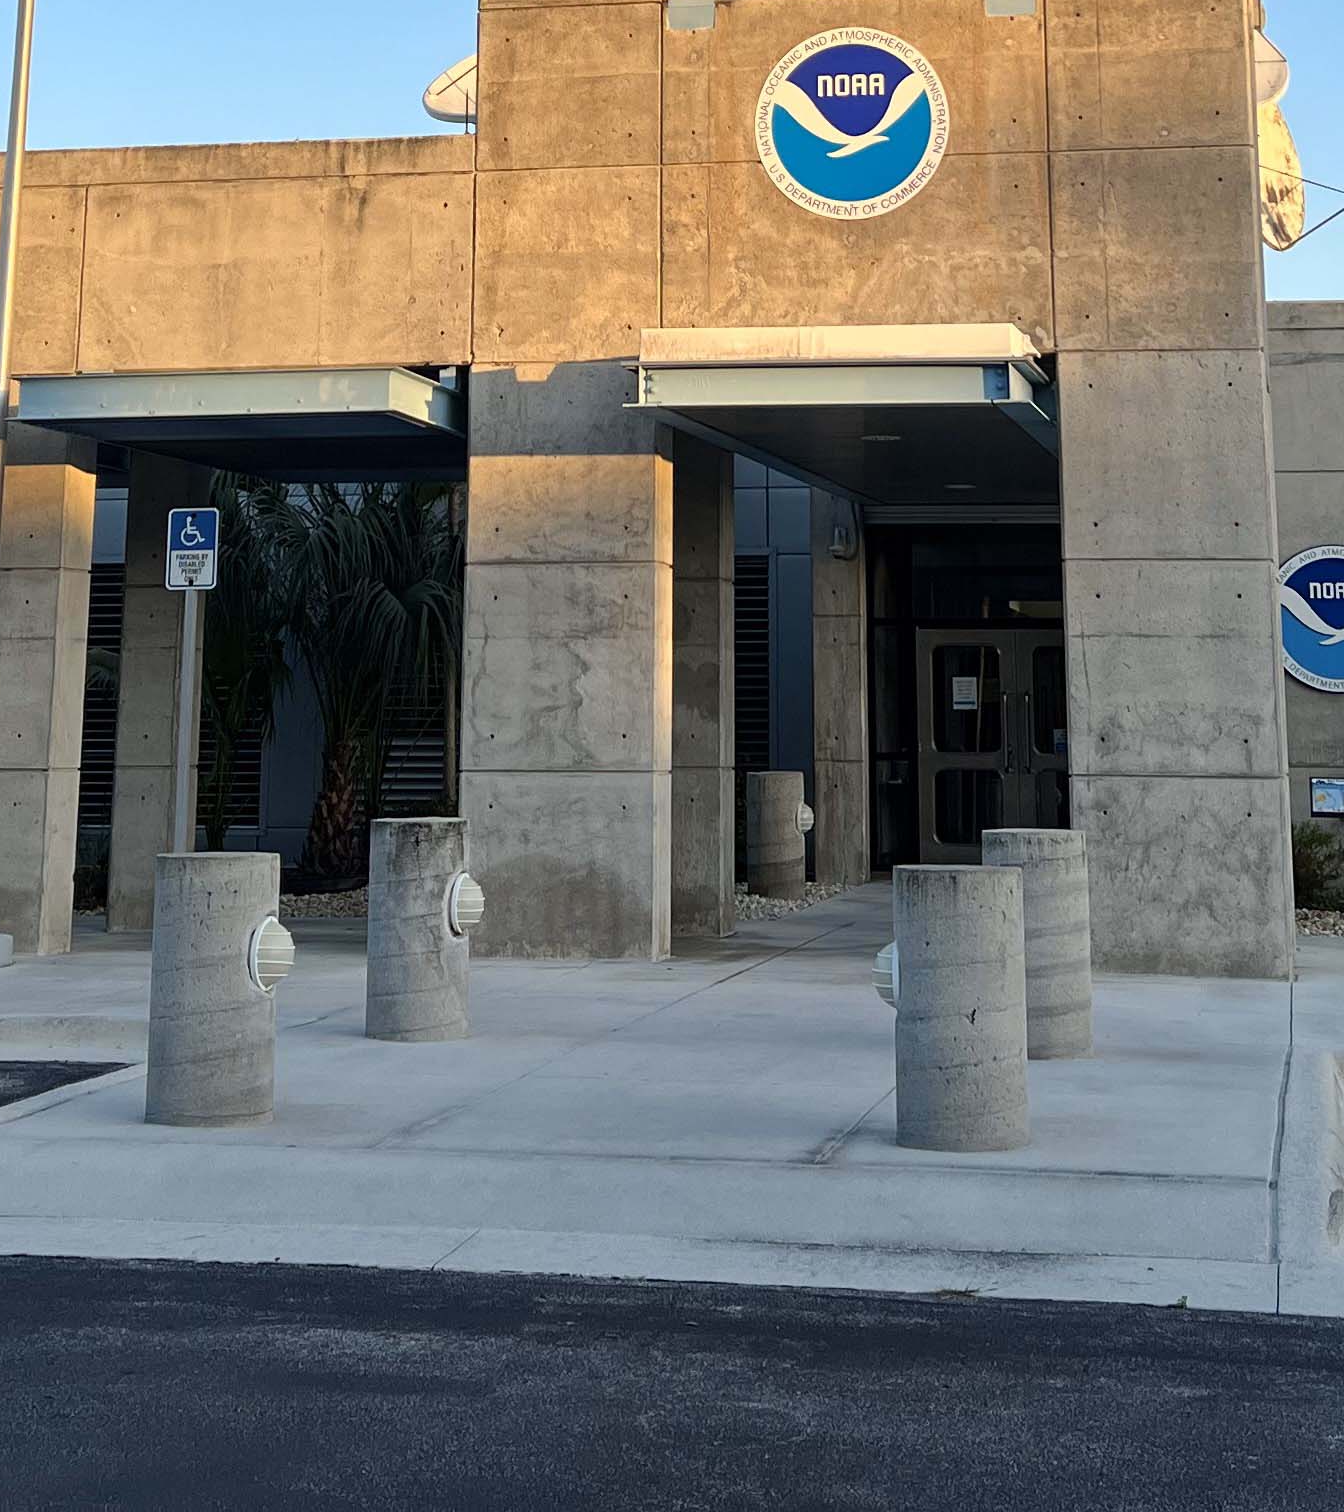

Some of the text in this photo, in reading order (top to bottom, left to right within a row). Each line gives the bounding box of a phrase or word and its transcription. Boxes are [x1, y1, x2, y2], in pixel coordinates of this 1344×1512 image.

[758, 31, 946, 156] NATIONAL OCEANIC AND ATMOSPHERIC ADMINISTRATION
[817, 73, 885, 97] NOAA
[785, 182, 859, 216] DEPARTMENT
[862, 202, 878, 215] OF
[880, 160, 936, 210] COMMERCE
[1299, 551, 1317, 564] AND
[1288, 663, 1344, 689] DEPARTMENT
